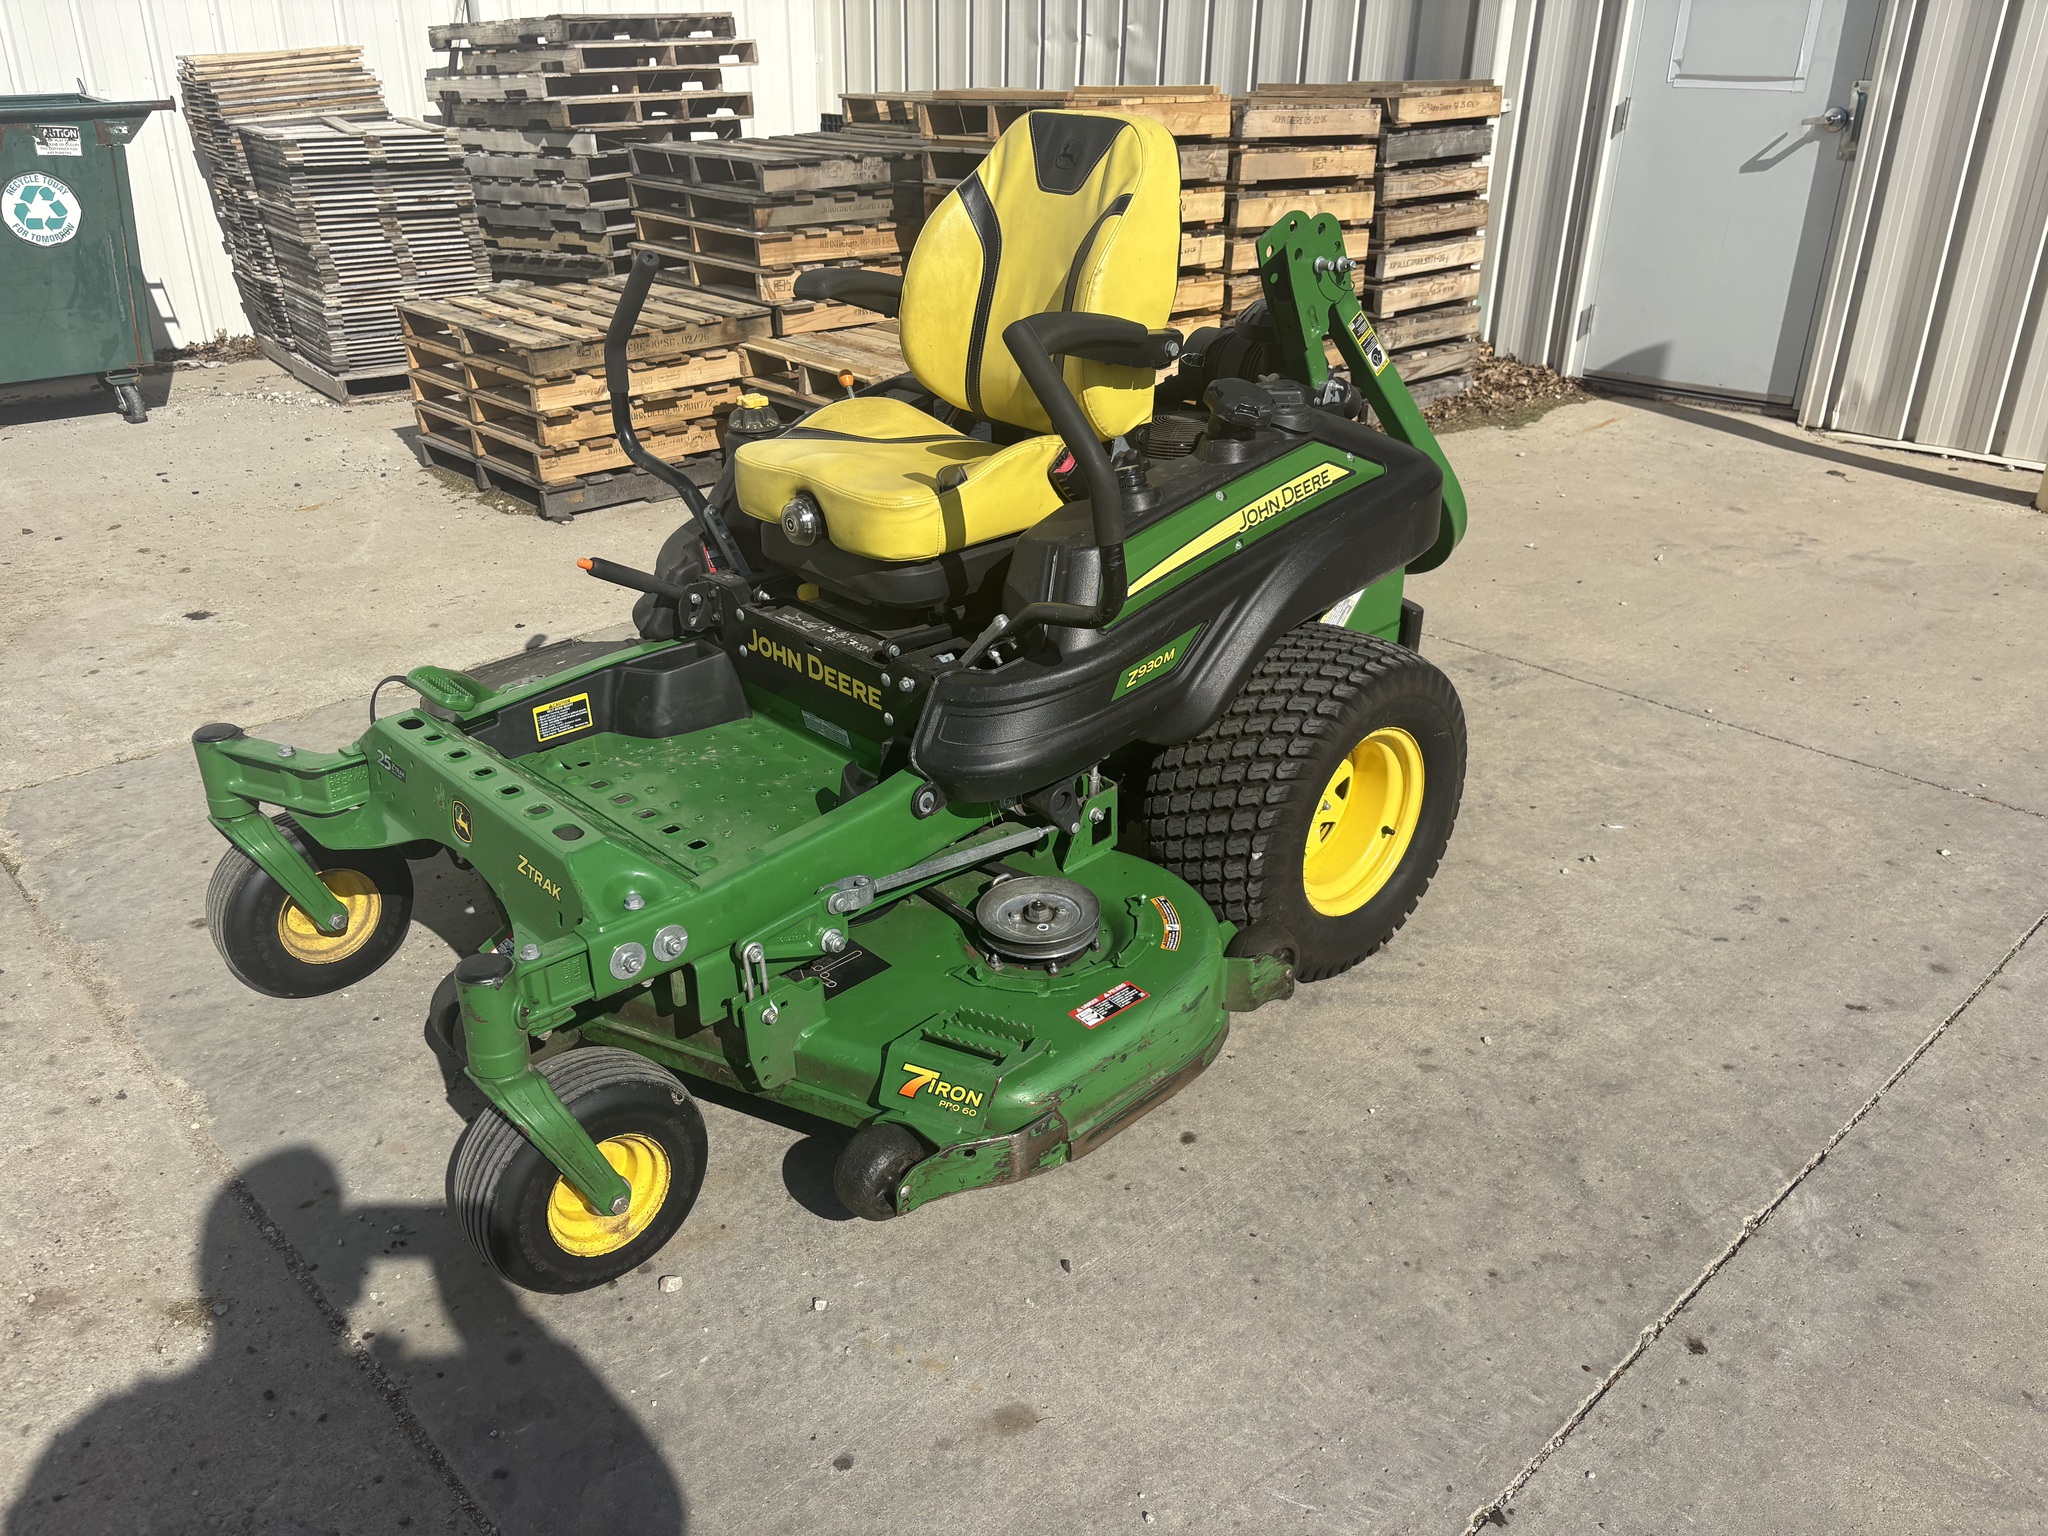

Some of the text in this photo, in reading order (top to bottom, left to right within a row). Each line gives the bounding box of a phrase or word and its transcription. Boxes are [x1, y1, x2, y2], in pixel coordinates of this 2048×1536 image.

[43, 127, 78, 138] AUTION
[6, 174, 70, 196] RECYCLE TODAY
[12, 222, 76, 243] FOR TOMORROW
[1239, 469, 1331, 532] JOHN DEERE
[747, 628, 802, 673] JOHN
[807, 653, 882, 711] DEERE
[1126, 648, 1176, 688] Z930M
[377, 748, 392, 771] 25
[517, 854, 562, 901] ZTRAK
[962, 1107, 977, 1117] 60
